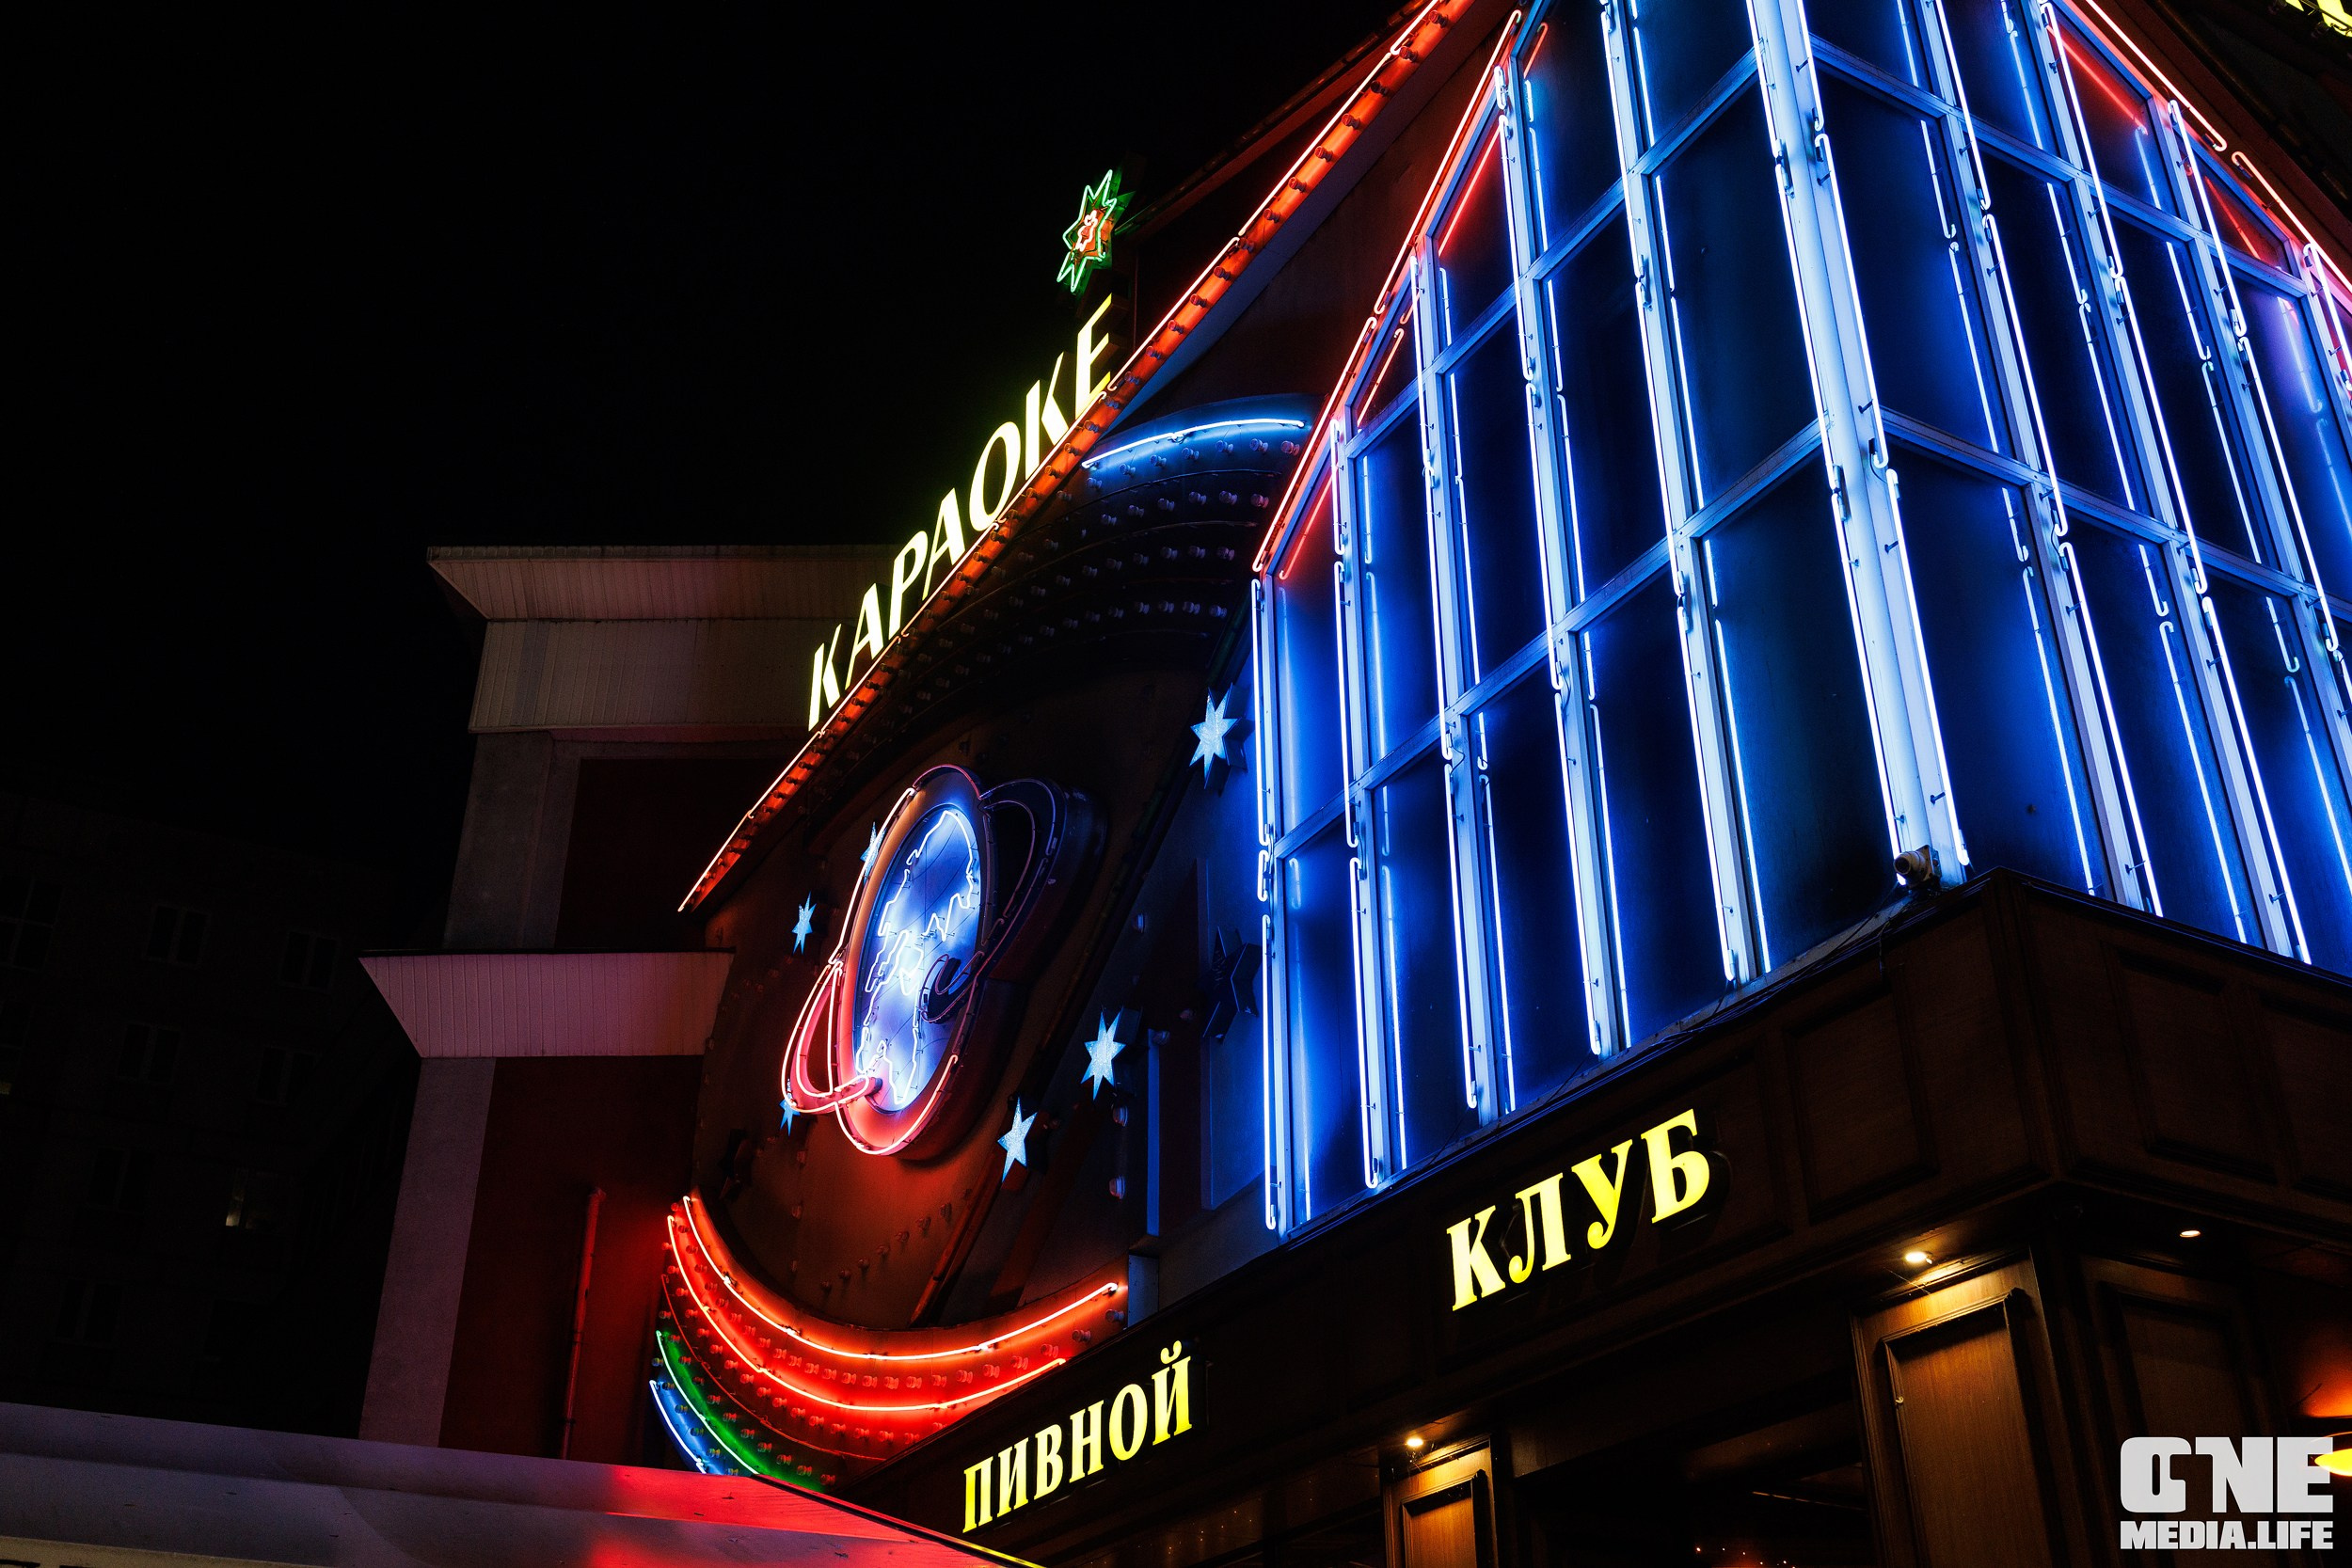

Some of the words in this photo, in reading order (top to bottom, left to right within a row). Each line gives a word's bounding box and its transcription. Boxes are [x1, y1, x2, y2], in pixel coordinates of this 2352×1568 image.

[808, 293, 1112, 731] КАРАОКЕ
[962, 1340, 1192, 1533] ПИВНОЙ
[1446, 1108, 1710, 1311] КЛУБ
